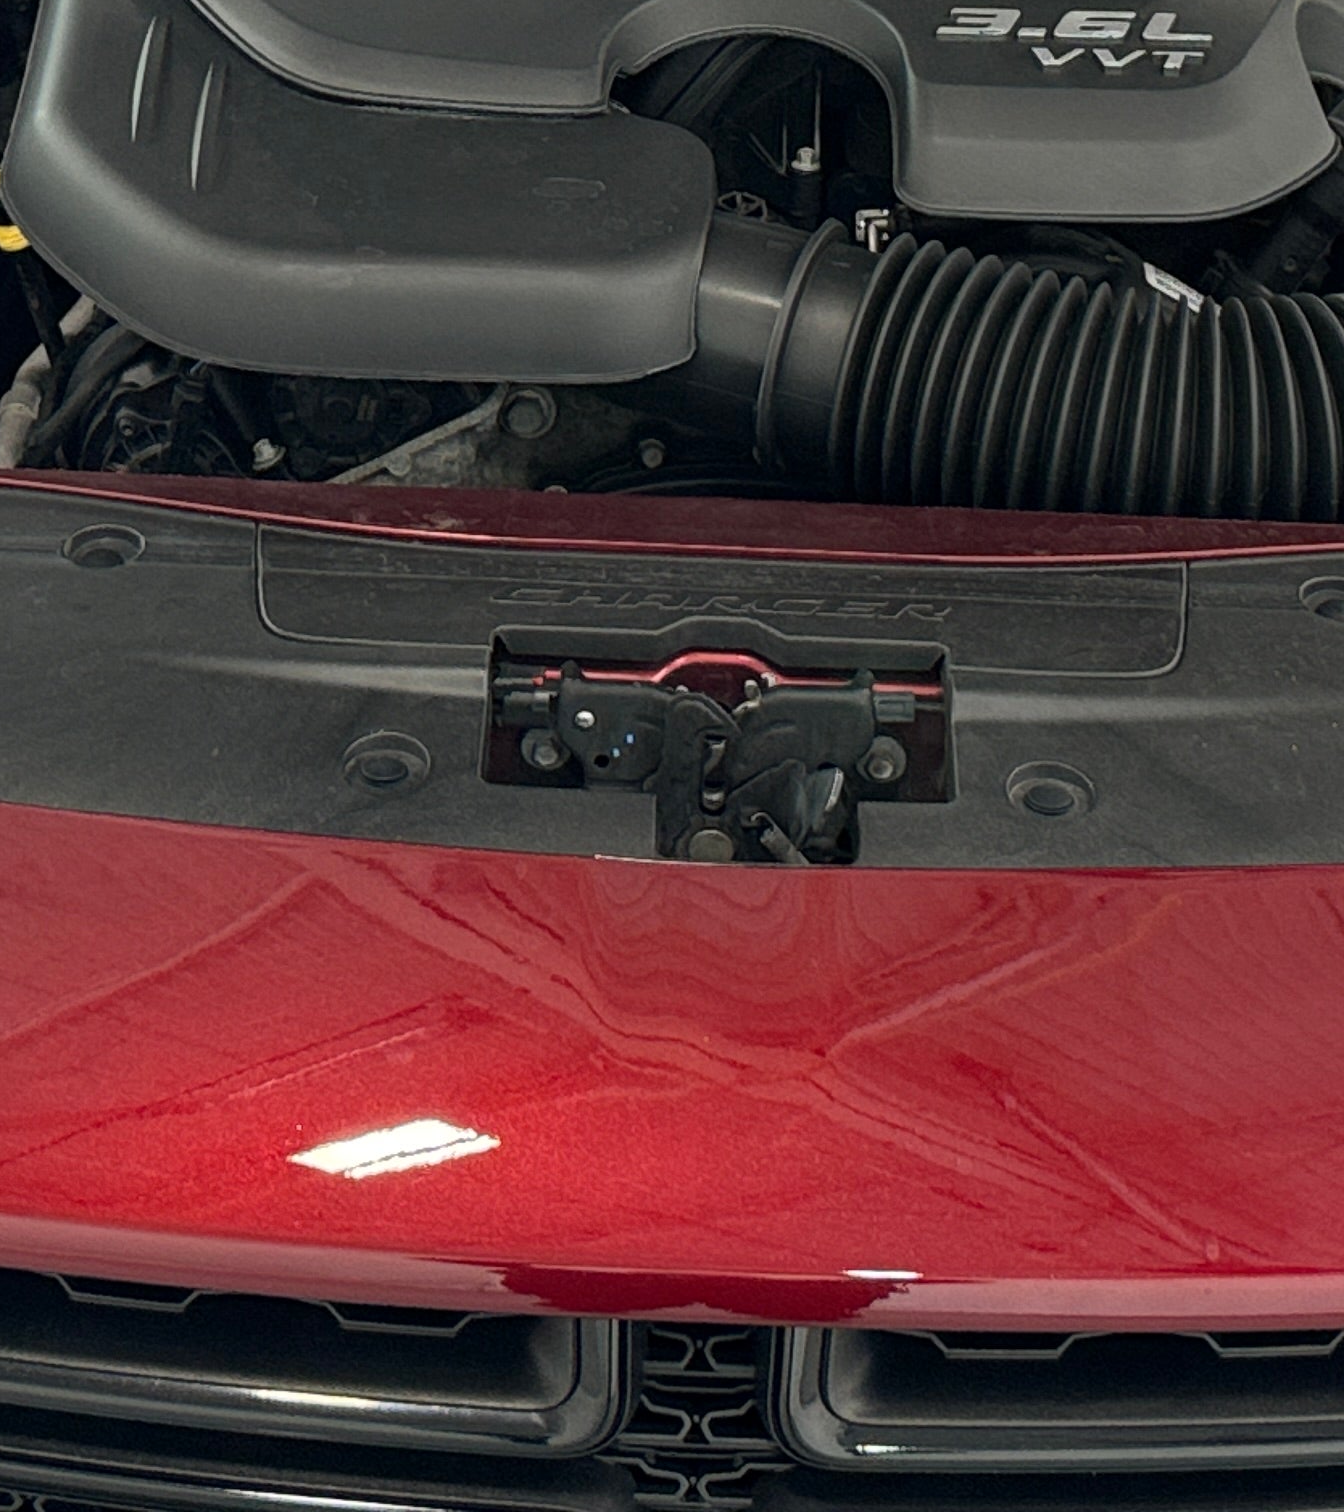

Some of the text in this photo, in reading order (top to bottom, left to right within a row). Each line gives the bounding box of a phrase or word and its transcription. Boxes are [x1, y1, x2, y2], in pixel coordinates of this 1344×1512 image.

[936, 7, 1213, 43] 3.6L
[1031, 46, 1205, 75] VVT
[489, 588, 953, 622] CHARGER
